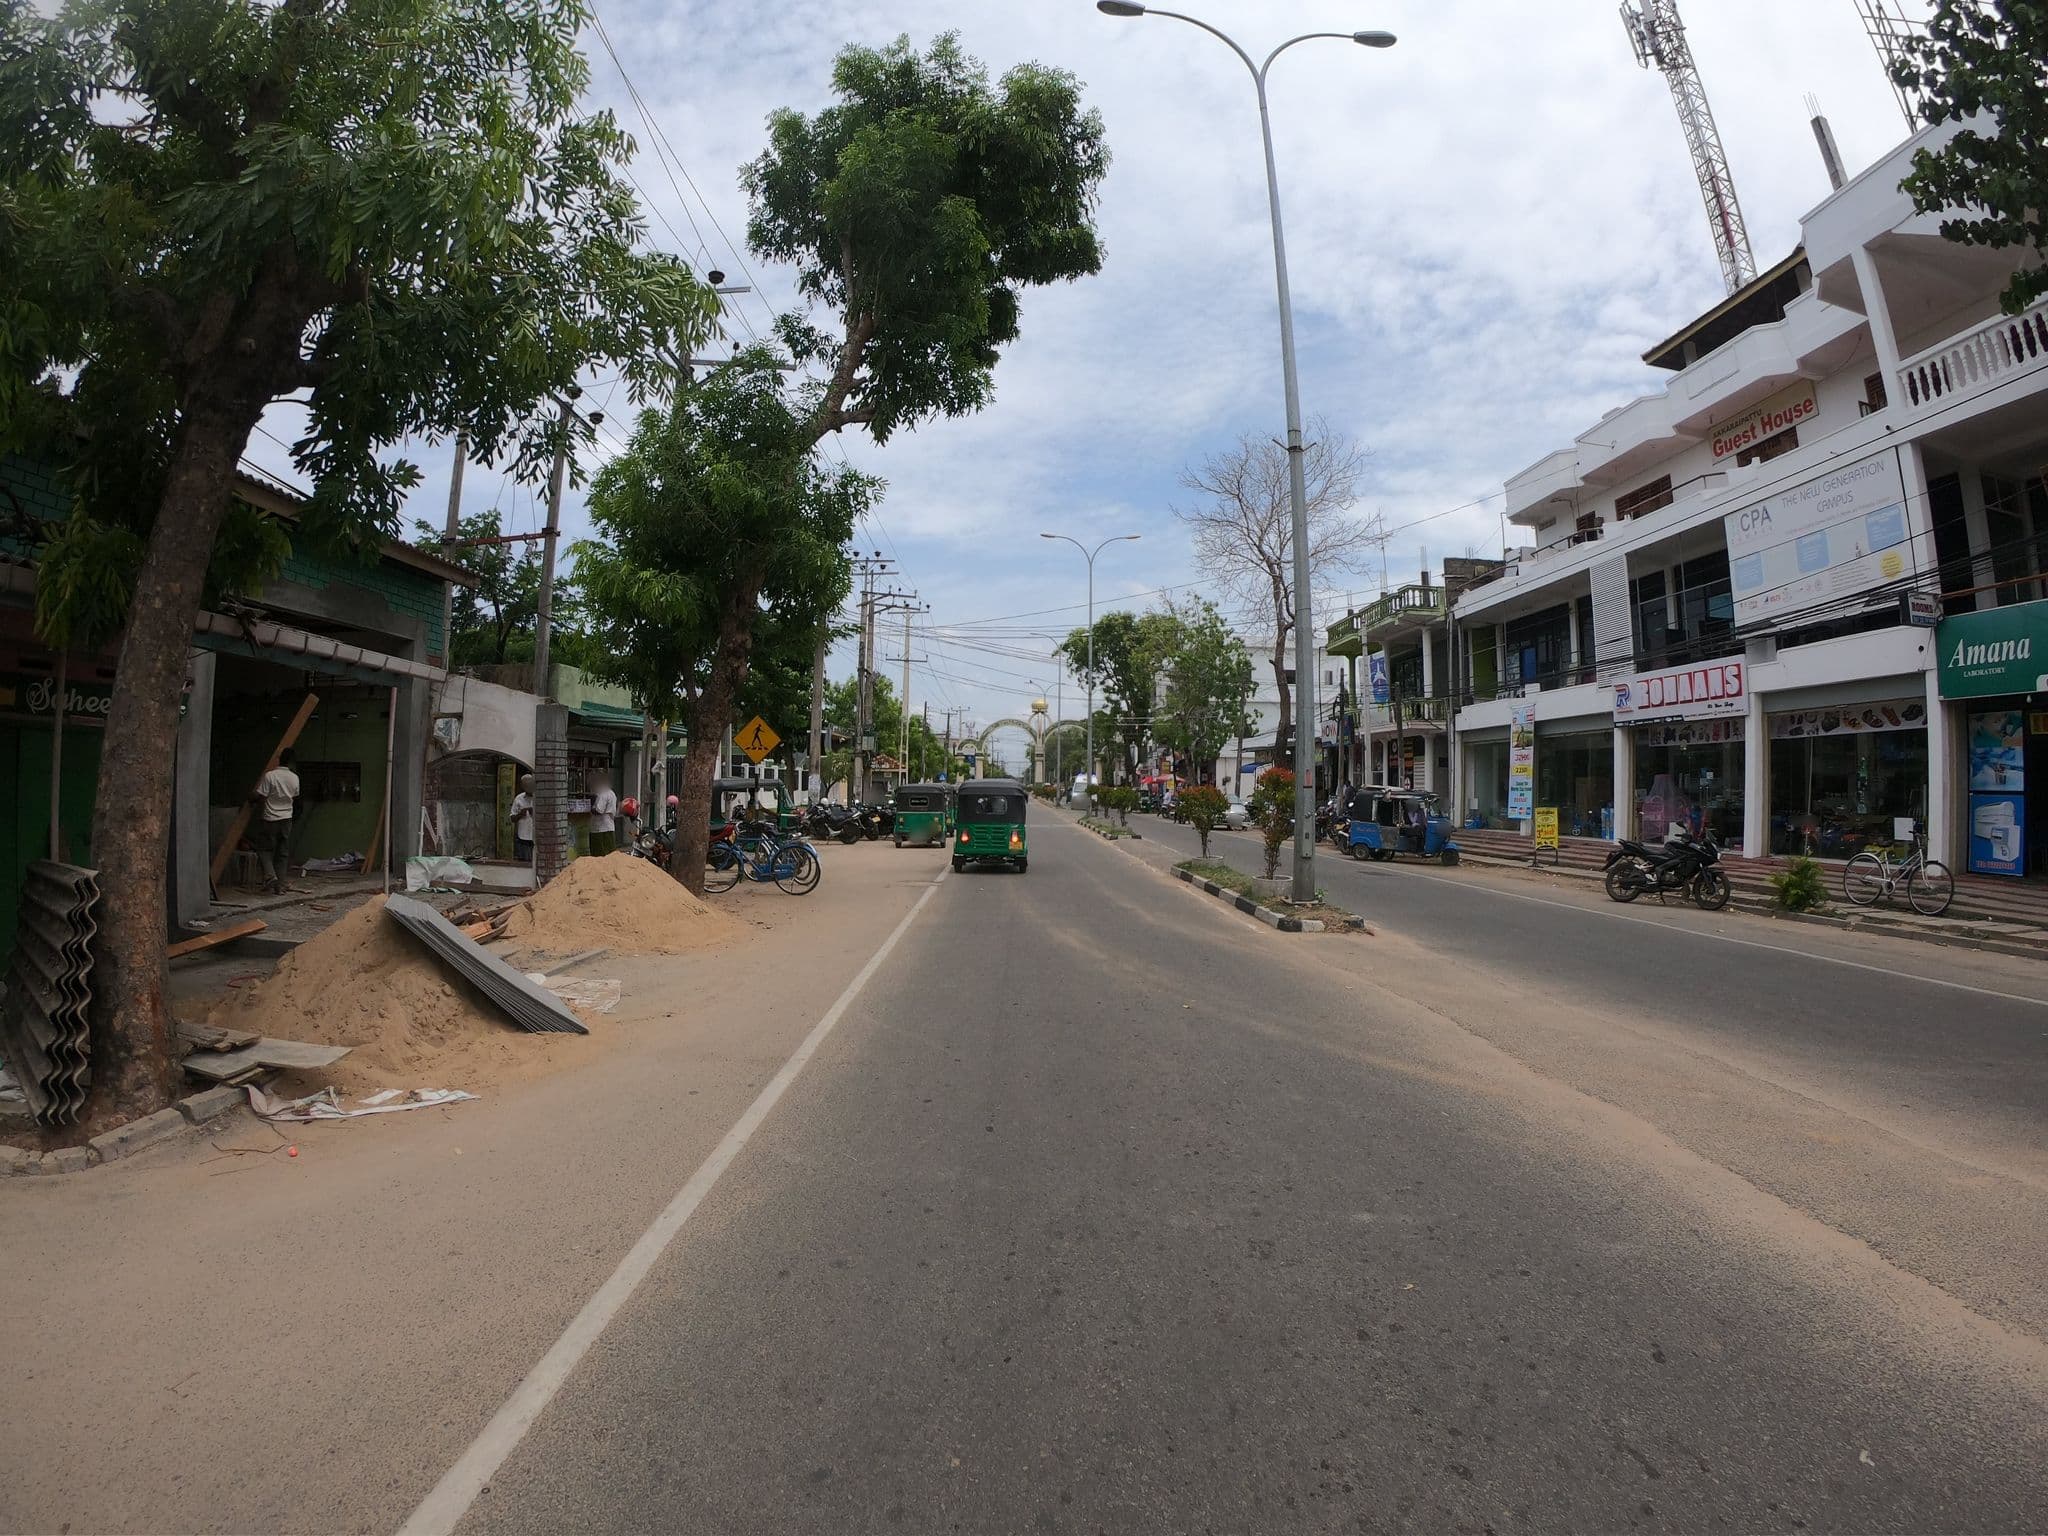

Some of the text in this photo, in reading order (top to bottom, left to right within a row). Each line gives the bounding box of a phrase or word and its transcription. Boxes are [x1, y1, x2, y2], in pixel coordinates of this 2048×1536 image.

[1712, 398, 1814, 457] Guest House
[1781, 460, 1885, 509] THE NEW GENERATION
[1816, 490, 1854, 513] CAMPUS
[1740, 505, 1772, 532] CPA
[1948, 637, 2031, 668] Amana
[1963, 667, 2006, 678] LABORATORY
